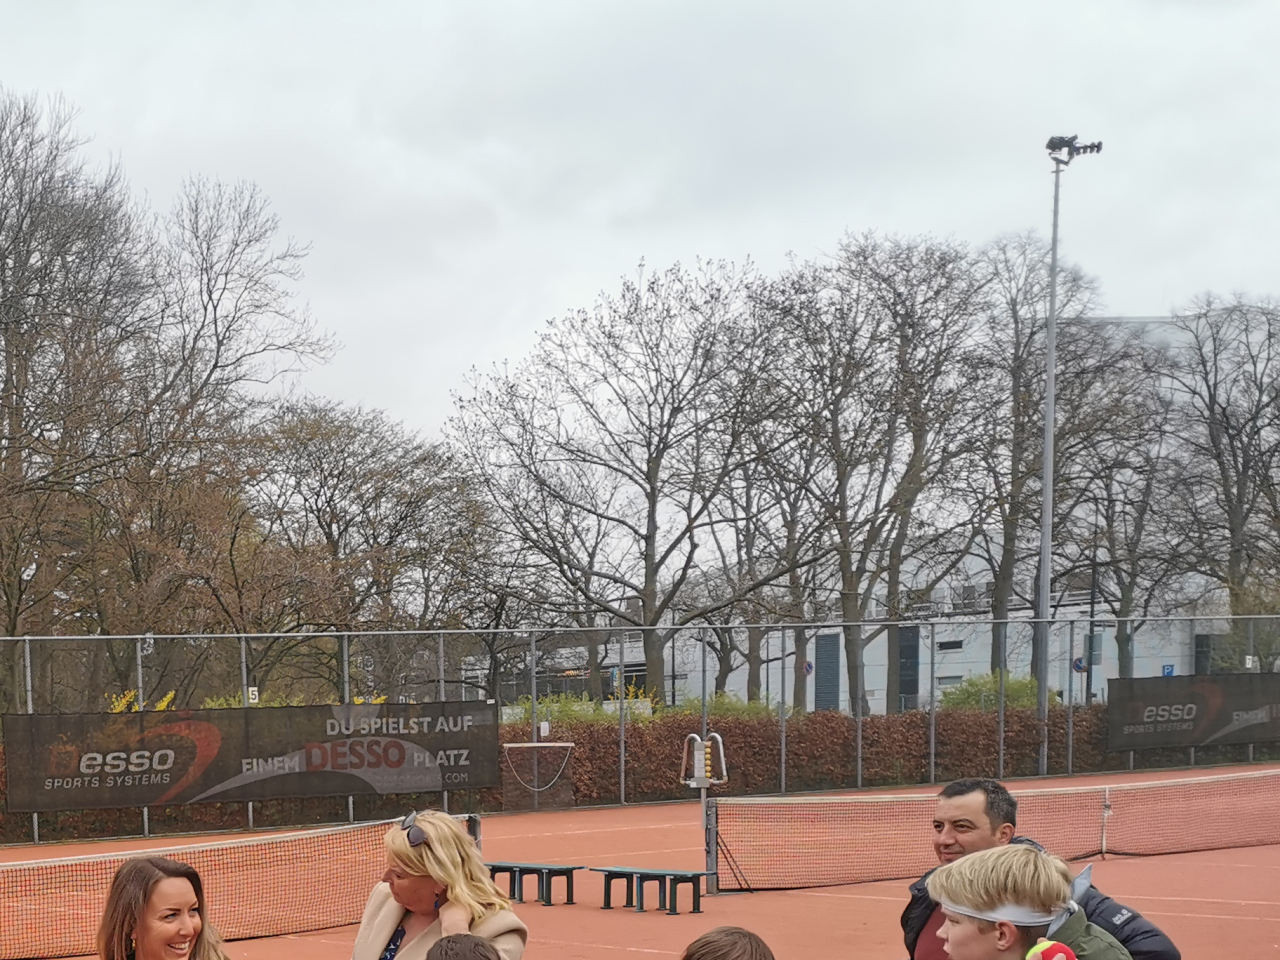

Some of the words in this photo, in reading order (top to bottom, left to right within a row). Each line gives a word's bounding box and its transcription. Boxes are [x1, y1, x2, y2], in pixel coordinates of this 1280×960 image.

[249, 689, 257, 700] 5
[326, 717, 356, 736] DU
[359, 715, 433, 736] SPIELST
[434, 715, 473, 733] AUF
[304, 739, 407, 772] DESSO
[413, 749, 471, 767] PLATZ
[44, 776, 100, 790] SPORTS
[106, 773, 171, 788] SYSTEMS
